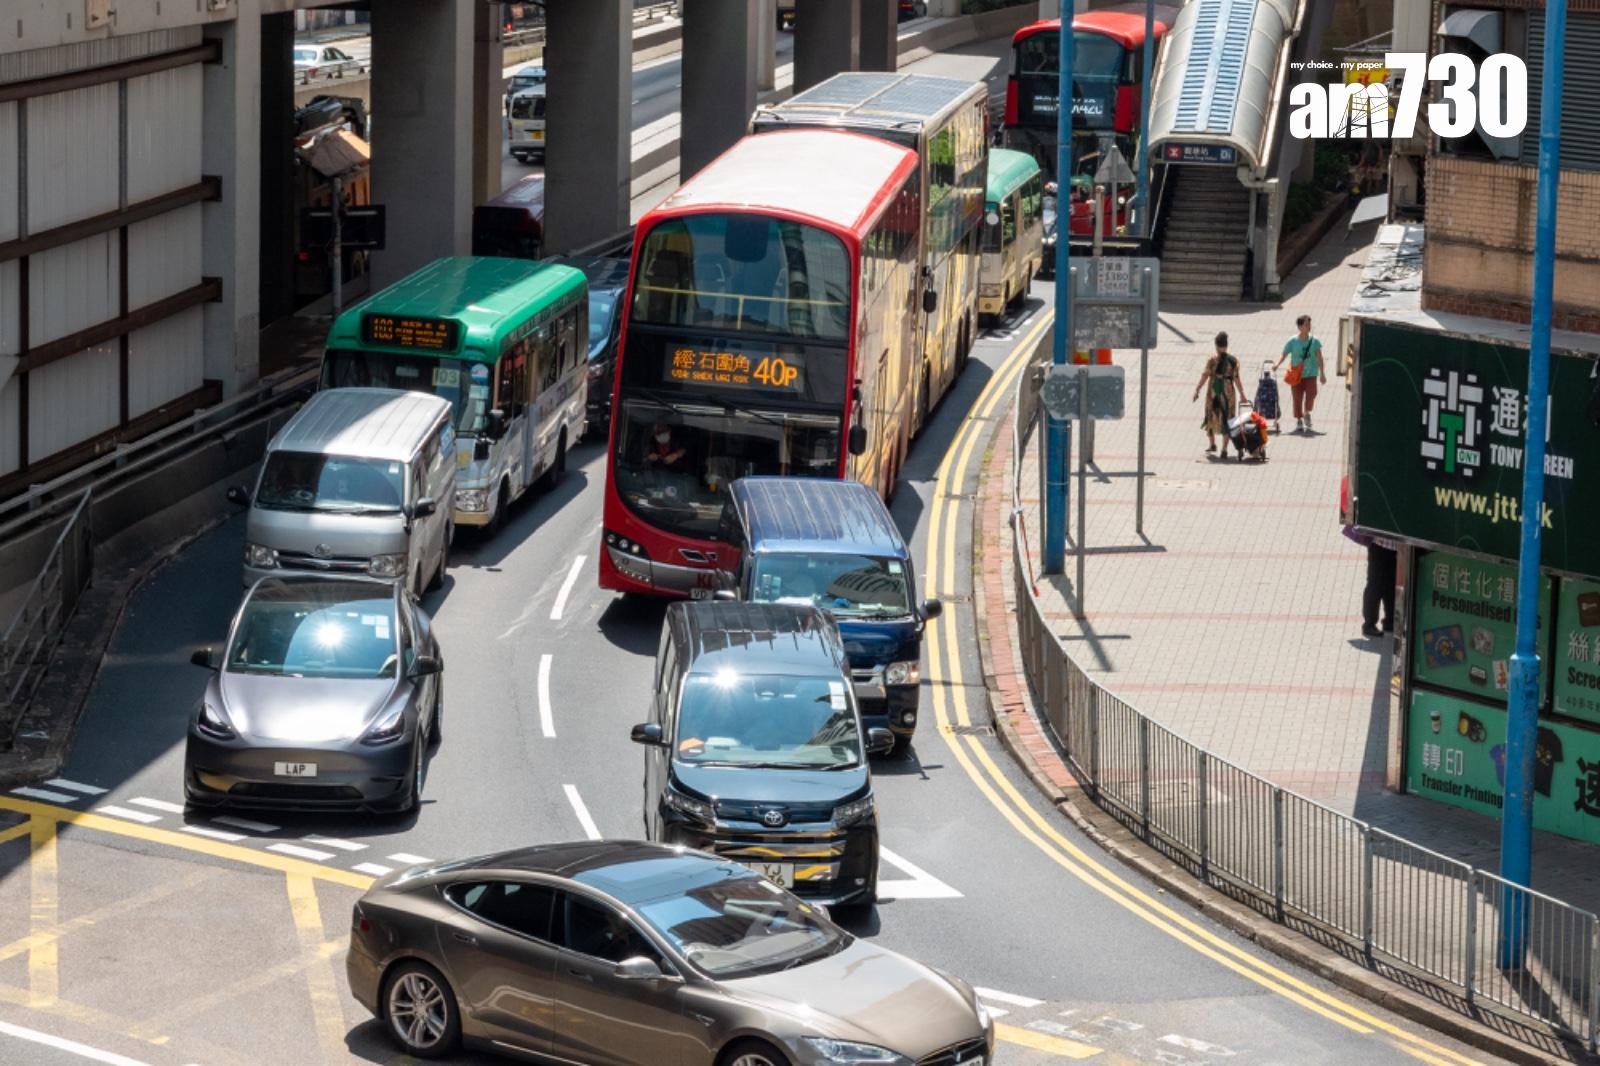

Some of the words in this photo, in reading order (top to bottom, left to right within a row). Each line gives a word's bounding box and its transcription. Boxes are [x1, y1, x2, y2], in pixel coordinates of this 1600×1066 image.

[753, 357, 798, 387] 40P
[1489, 443, 1523, 469] TONY
[1434, 486, 1553, 529] www.jtt.k
[1432, 590, 1511, 623] Personalised
[286, 763, 306, 775] LAP
[1422, 773, 1462, 797] Transfer
[1464, 784, 1503, 809] Printing
[763, 864, 781, 875] YJ
